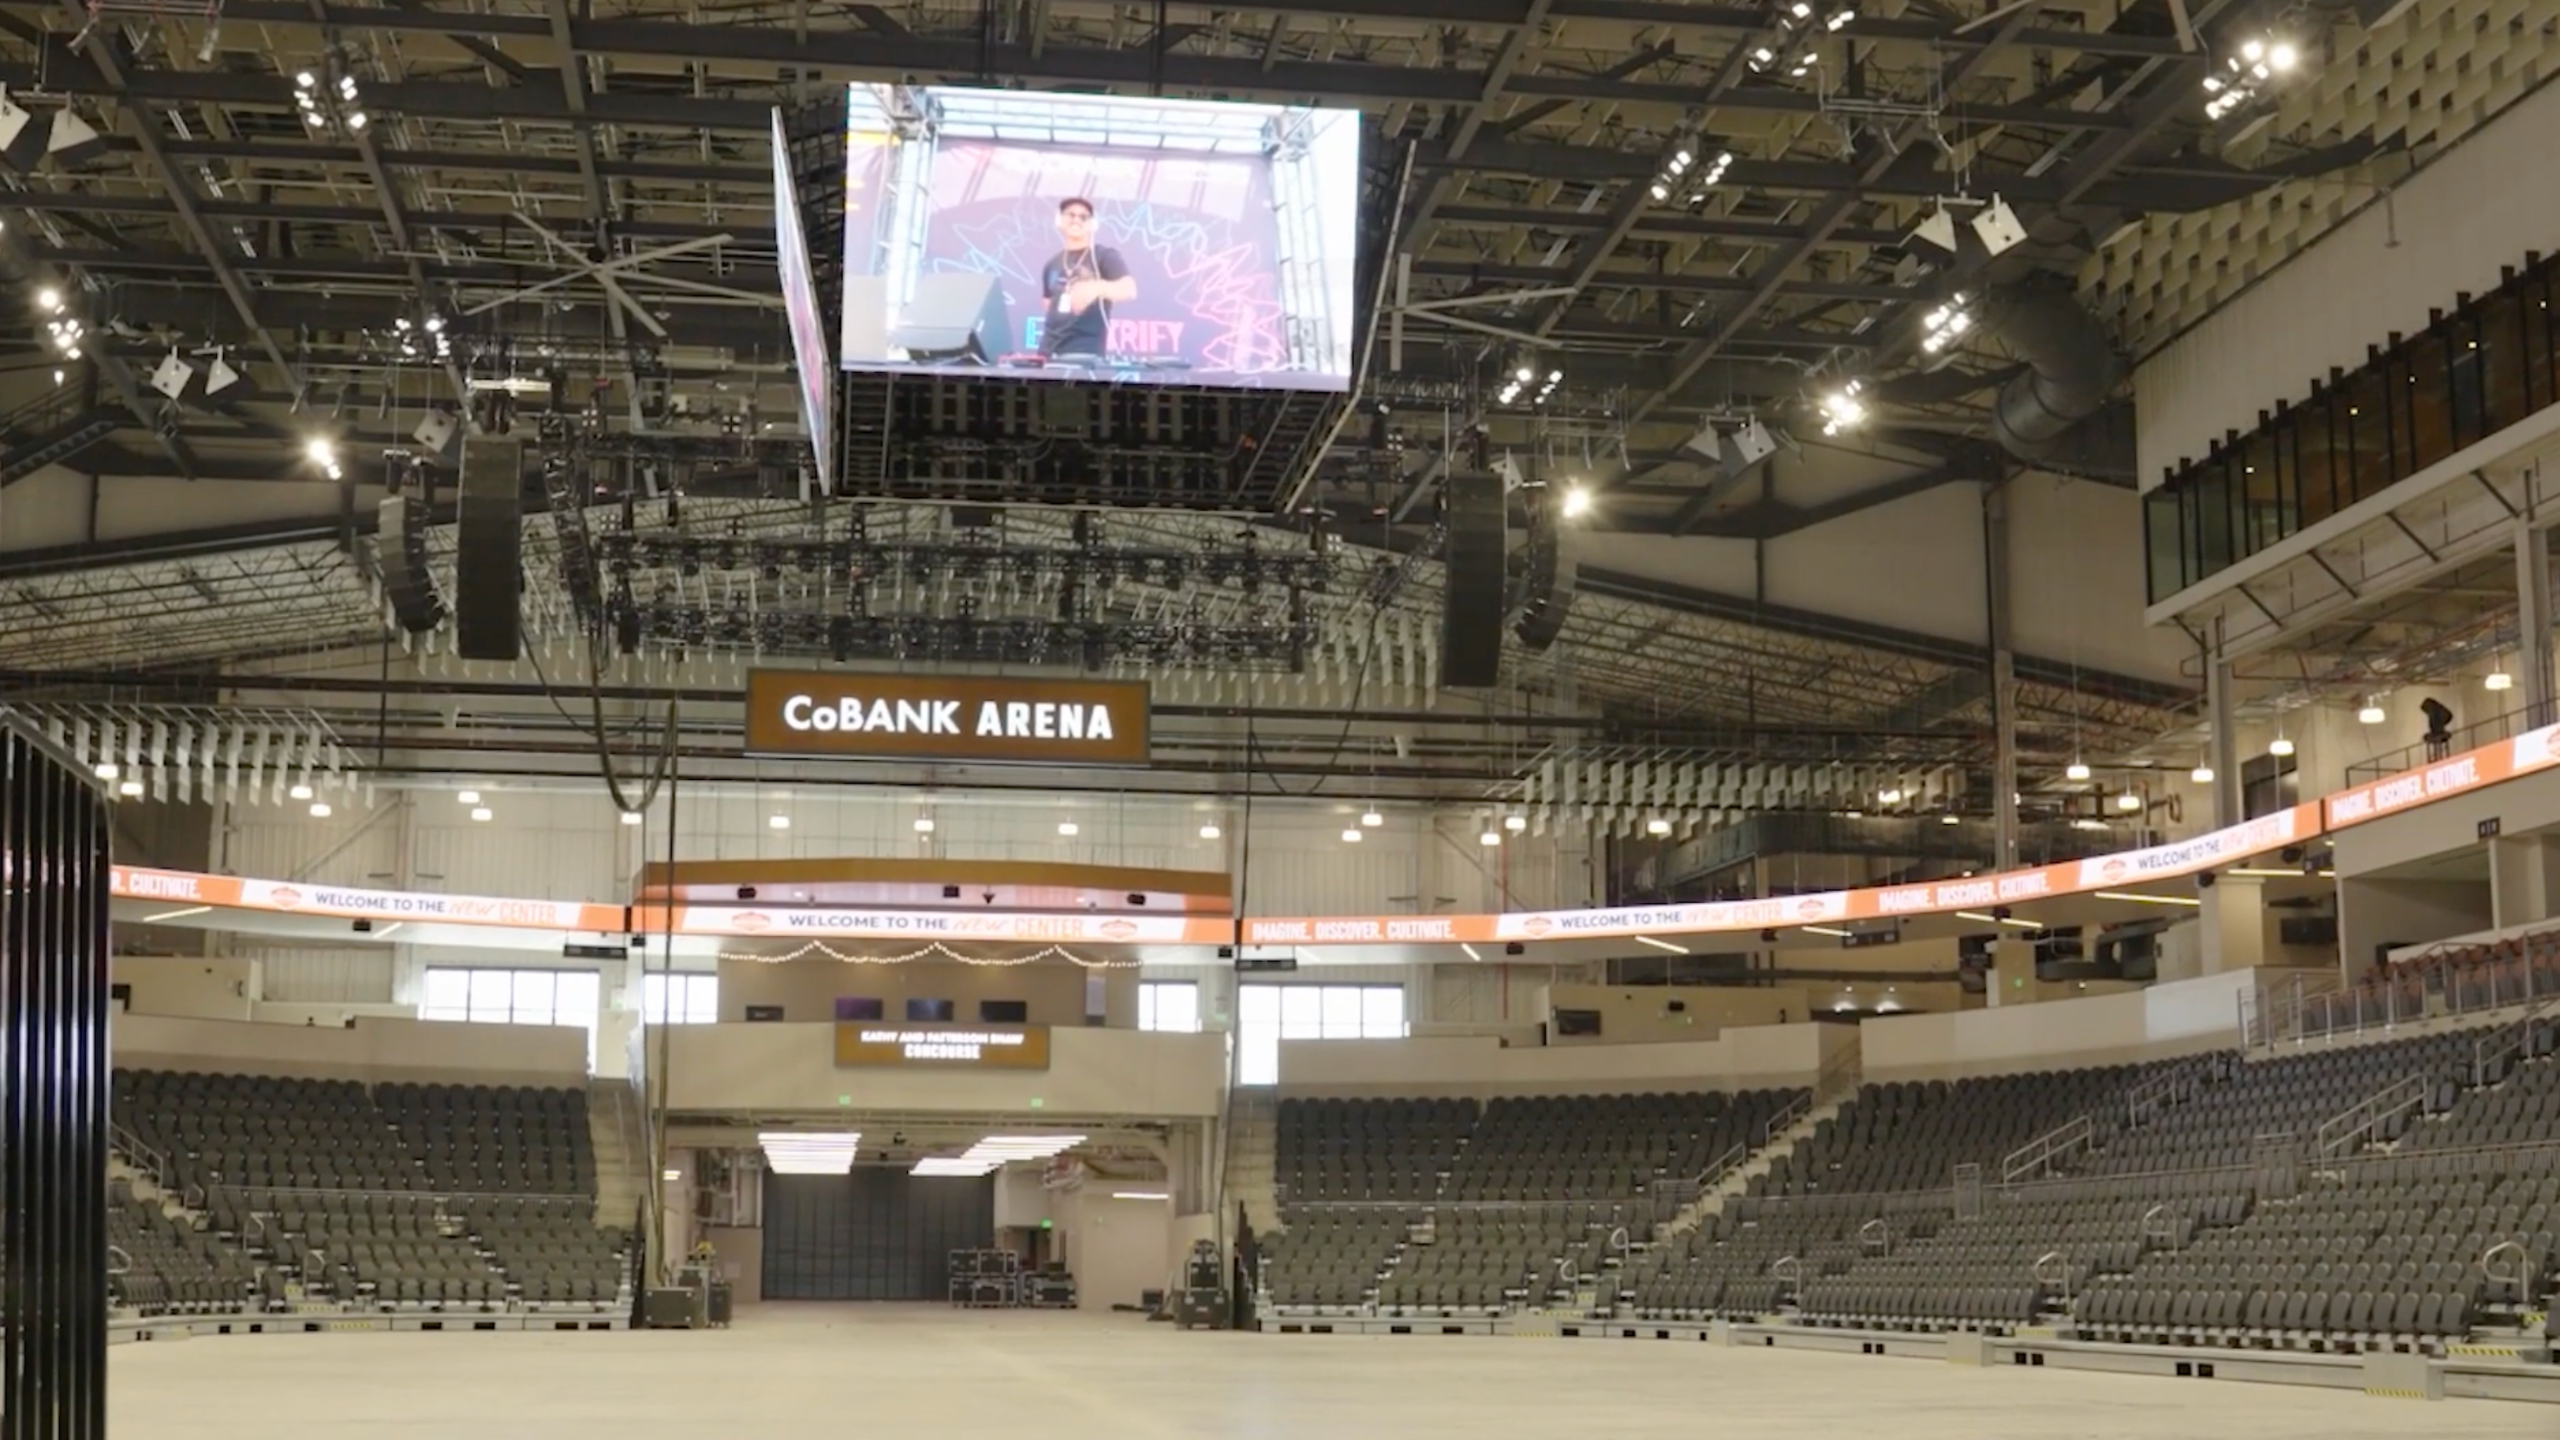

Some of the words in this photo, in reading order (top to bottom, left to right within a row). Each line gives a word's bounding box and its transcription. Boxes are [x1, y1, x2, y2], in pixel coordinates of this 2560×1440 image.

[784, 695, 960, 735] CoBANK
[976, 701, 1113, 739] ARENA
[2138, 848, 2192, 870] WELCOME
[2193, 844, 2204, 859] TO
[2205, 839, 2220, 854] THE
[129, 873, 201, 898] CULTIVATE.
[1879, 888, 1934, 912] IMAGINE.
[1936, 881, 1997, 906] DISCOVER.
[316, 891, 388, 910] WELCOME
[394, 898, 413, 911] TO
[418, 900, 445, 913] THE
[500, 902, 557, 924] CENTER
[1562, 914, 1629, 928] WELCOME
[1635, 913, 1651, 925] TO
[1656, 911, 1682, 923] THE
[789, 915, 880, 928] WELCOME
[885, 917, 908, 929] TO
[914, 917, 949, 930] THE
[1014, 917, 1084, 938] CENTER
[1252, 922, 1311, 940] IMAGINE.
[1315, 921, 1383, 940] DISCOVER.
[1387, 920, 1456, 939] CULTIVATE.
[861, 1031, 898, 1042] KATHY
[899, 1032, 925, 1043] AND
[904, 1044, 980, 1059] CONCOURSE
